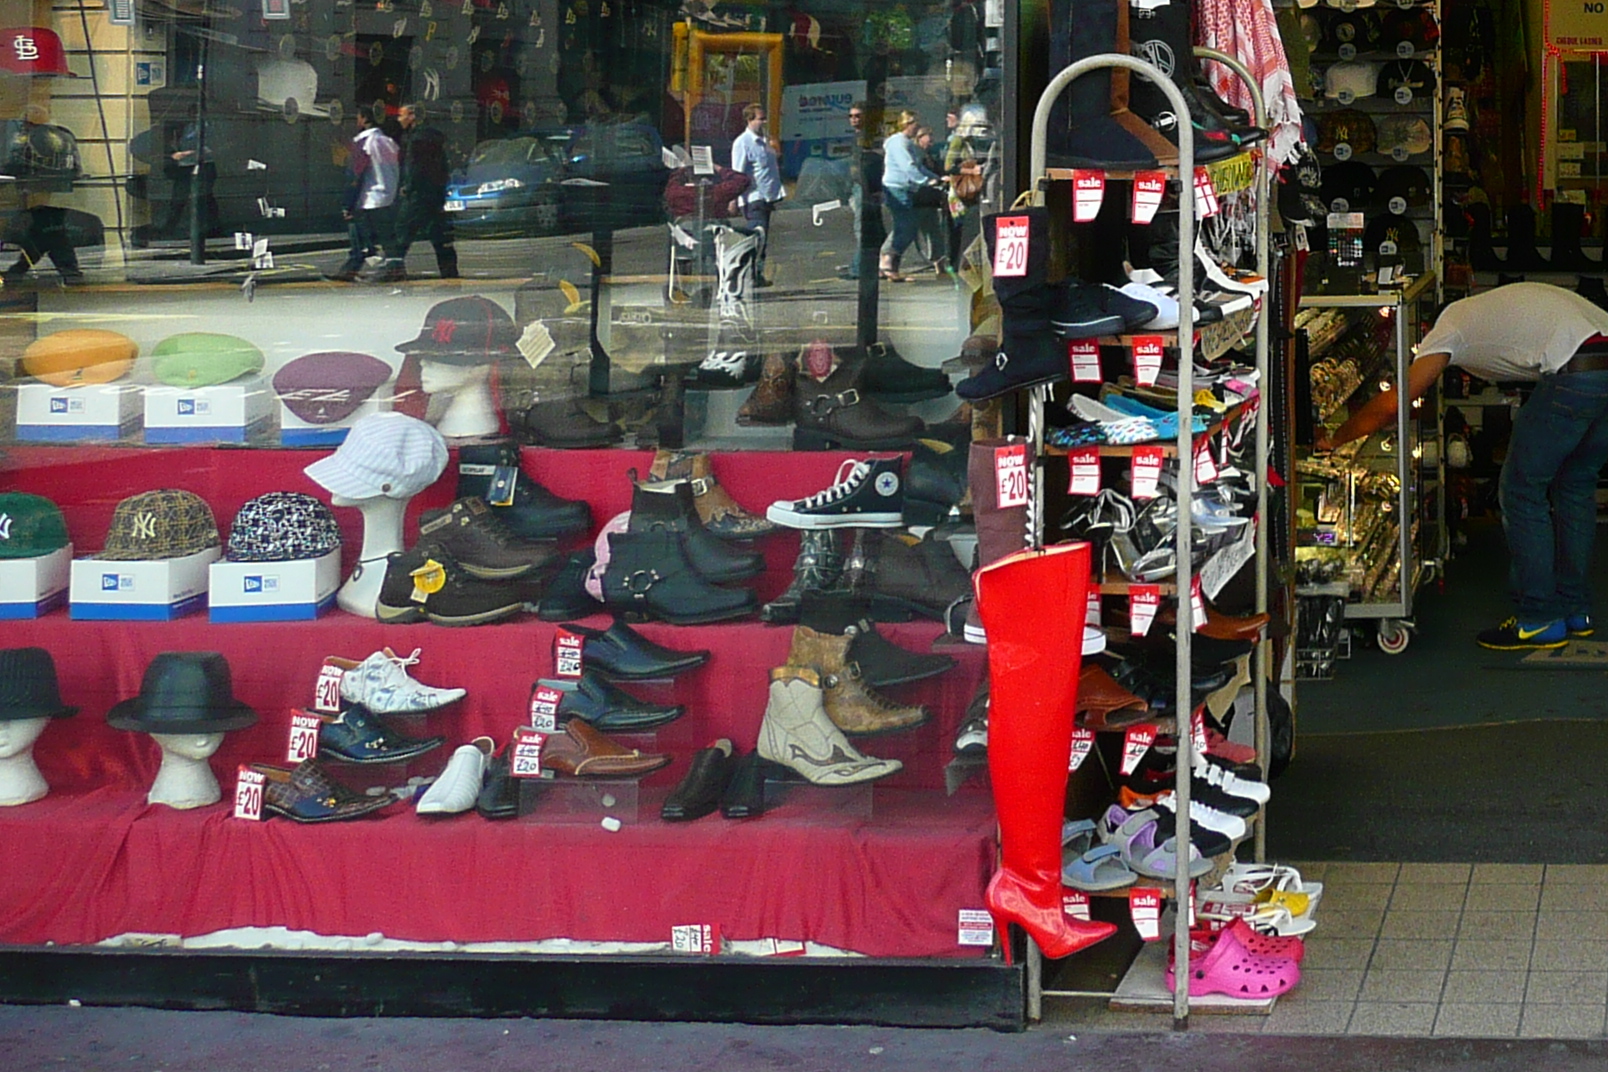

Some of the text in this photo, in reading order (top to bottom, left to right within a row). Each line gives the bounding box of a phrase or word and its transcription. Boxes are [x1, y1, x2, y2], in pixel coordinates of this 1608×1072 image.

[1583, 2, 1605, 14] NO
[1076, 176, 1101, 189] sale
[1138, 179, 1162, 191] sale
[999, 226, 1028, 239] NOW
[998, 246, 1025, 271] £20
[1072, 342, 1096, 354] sale
[1136, 343, 1160, 355] sale
[998, 455, 1025, 467] NOW
[1072, 453, 1096, 466] sale
[1135, 453, 1160, 466] sale
[1000, 477, 1025, 501] £20
[1132, 592, 1157, 604] sale
[558, 636, 580, 647] sale
[321, 664, 344, 677] NOW
[316, 679, 339, 708] £20
[537, 690, 559, 702] sale
[292, 715, 320, 728] NOW
[521, 733, 543, 745] sale
[1130, 731, 1152, 744] sale
[290, 731, 317, 759] £20
[239, 770, 266, 783] NOW
[237, 787, 260, 816] £20
[1063, 893, 1086, 904] sale
[1133, 895, 1157, 907] sale
